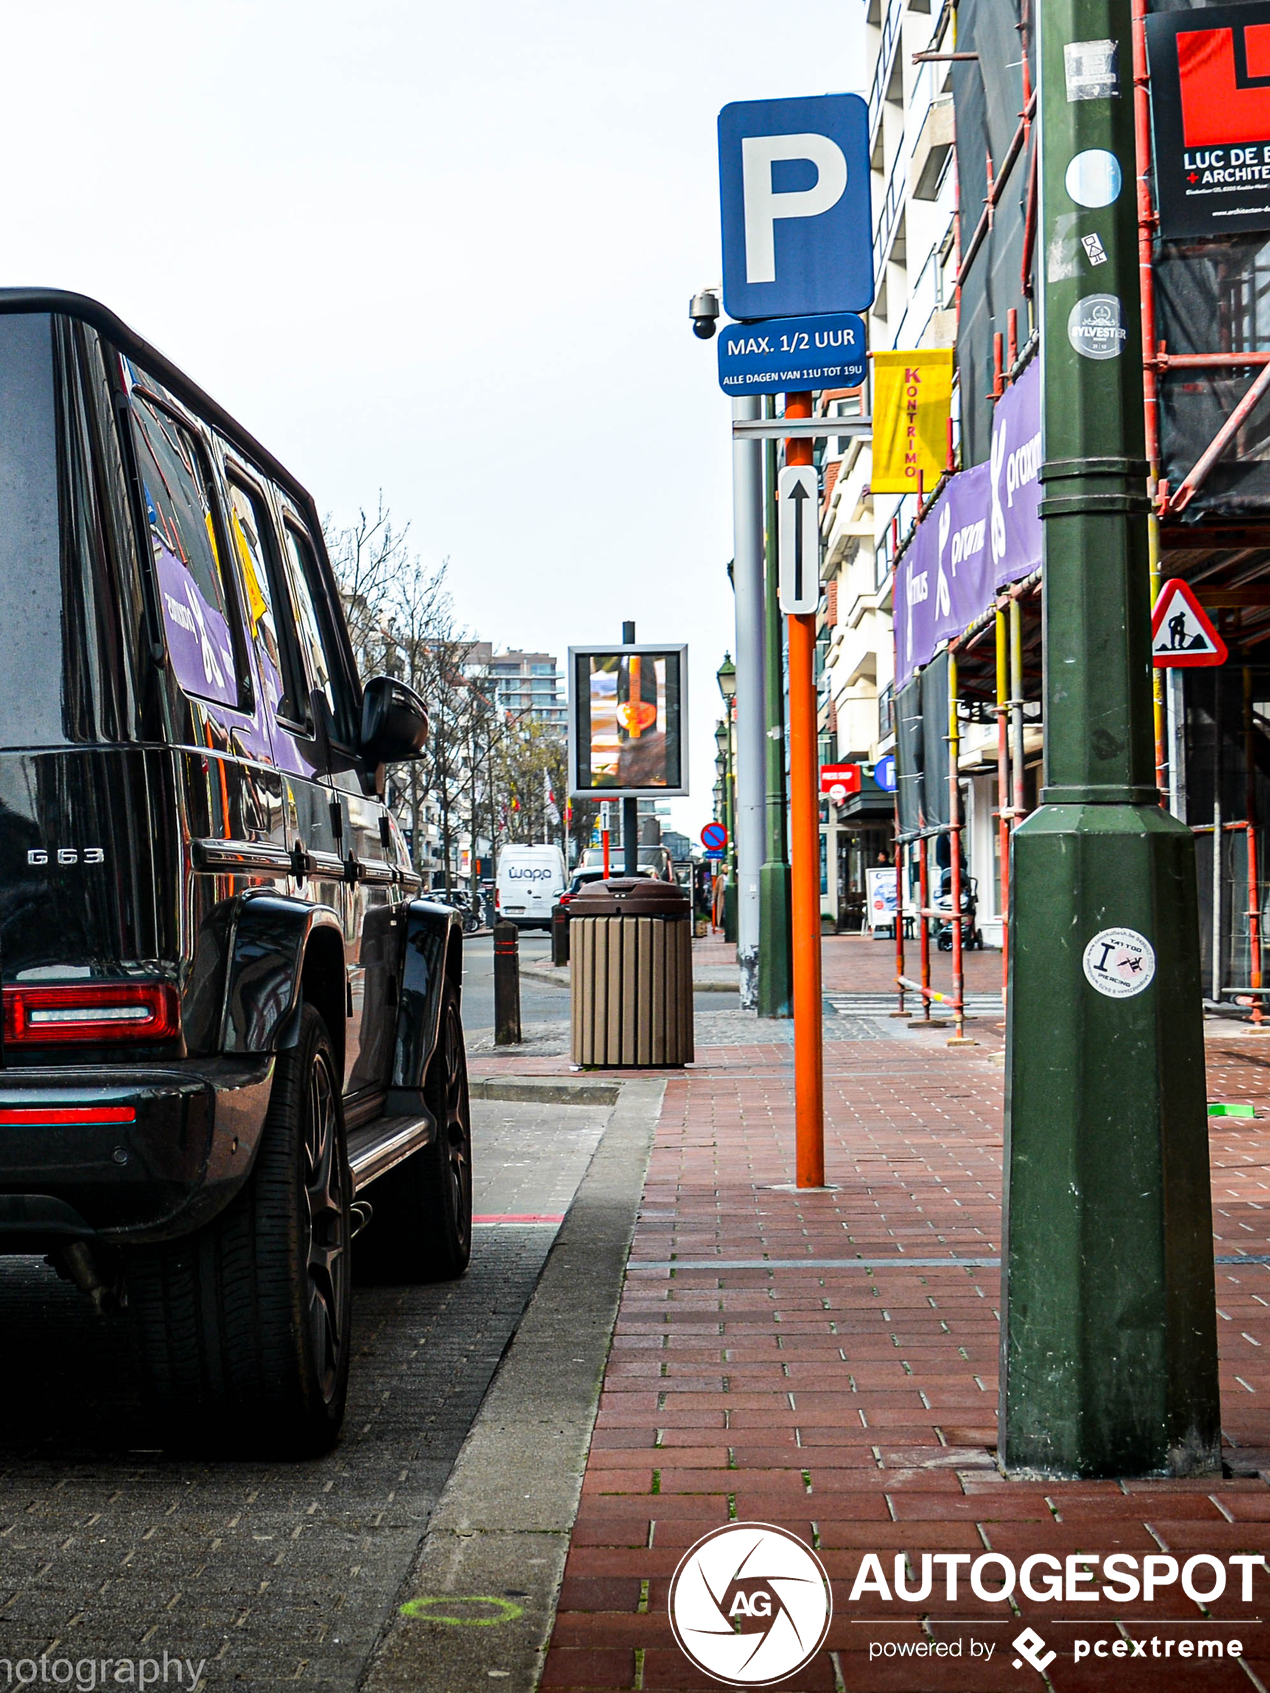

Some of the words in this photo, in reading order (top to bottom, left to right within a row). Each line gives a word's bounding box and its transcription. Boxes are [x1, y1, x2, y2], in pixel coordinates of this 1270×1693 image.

[1183, 150, 1225, 170] LUC
[1230, 147, 1258, 166] DE
[741, 132, 848, 284] P
[727, 337, 775, 356] MAX.
[780, 332, 810, 353] 1/2
[815, 329, 855, 348] UUR
[1071, 326, 1127, 340] SYLVESTER
[723, 375, 744, 385] ALLE
[746, 372, 779, 383] DAGEN
[780, 370, 801, 380] VAN
[802, 368, 821, 378] 11U
[823, 366, 841, 377] TOT
[843, 365, 863, 375] 19U
[904, 367, 921, 478] KONTRIMO
[1093, 942, 1116, 972] I
